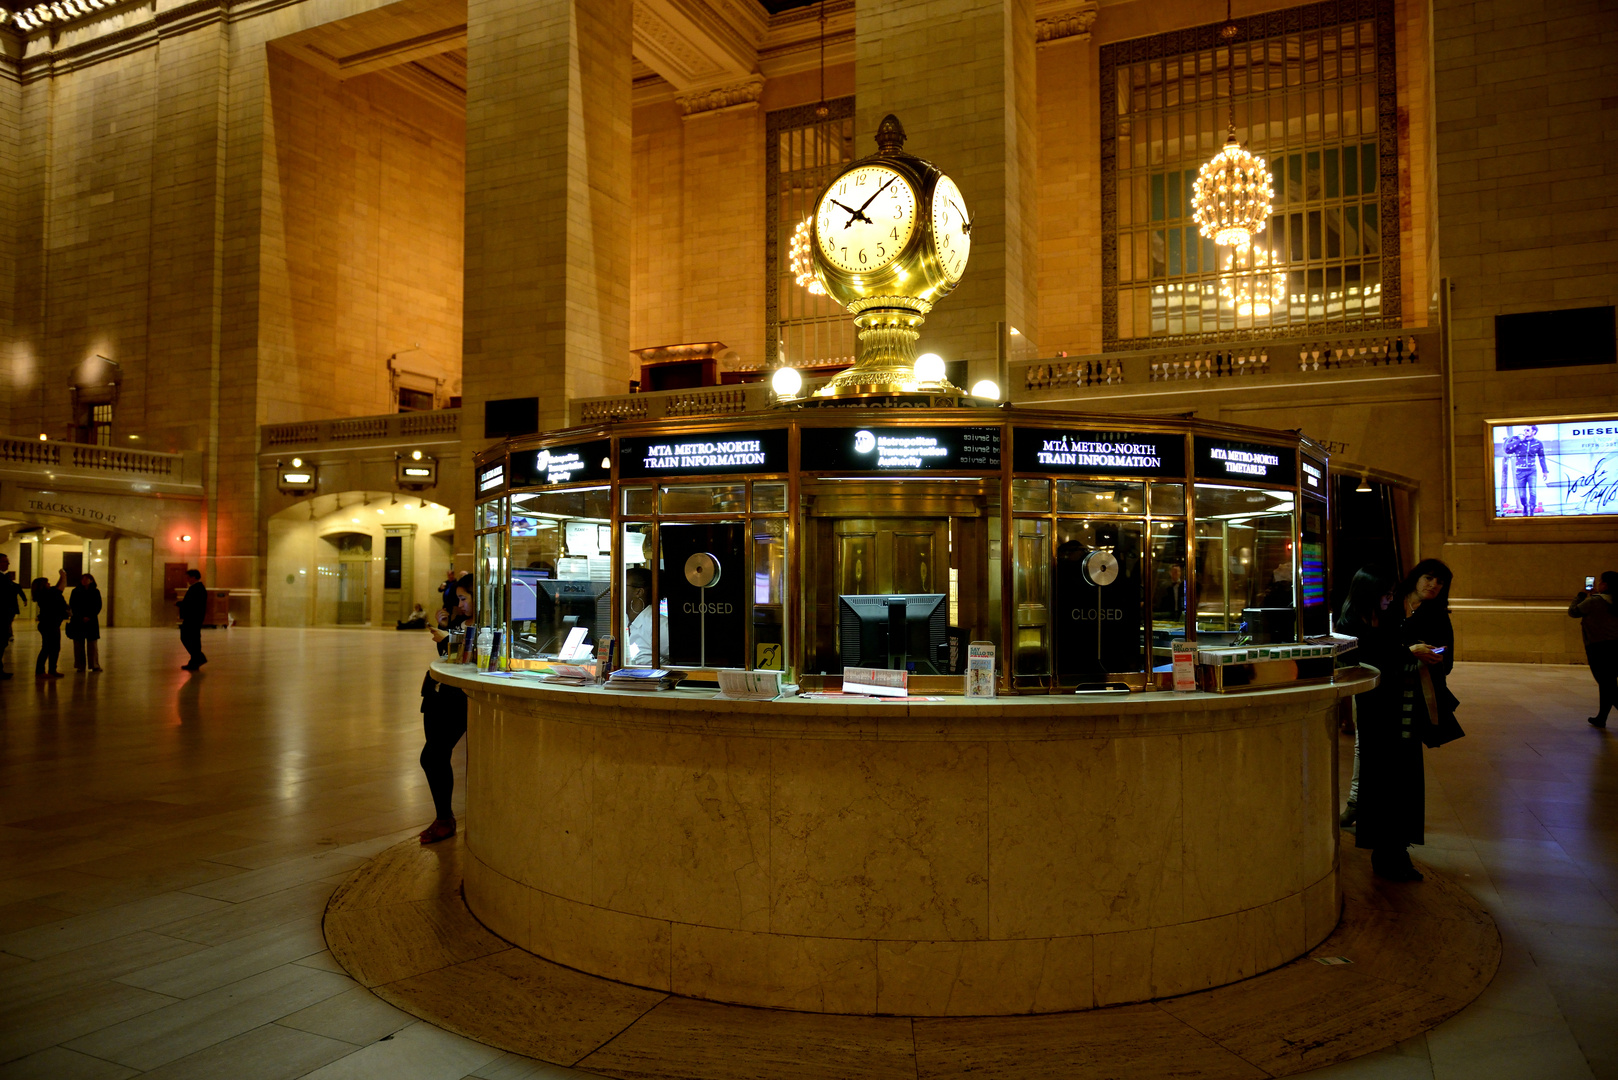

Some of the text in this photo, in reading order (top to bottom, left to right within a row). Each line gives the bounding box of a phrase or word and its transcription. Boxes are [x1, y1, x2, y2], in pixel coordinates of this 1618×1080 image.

[855, 173, 867, 187] 12
[839, 182, 847, 196] 11
[890, 185, 898, 199] 2
[893, 204, 903, 220] 3
[942, 211, 949, 227] 9
[823, 217, 830, 232] 9
[889, 225, 900, 241] 4
[828, 236, 836, 251] 8
[942, 233, 950, 249] 8
[841, 247, 847, 261] 7
[859, 248, 867, 264] 6
[876, 242, 885, 257] 5
[648, 444, 672, 456] MTA
[674, 440, 761, 456] METRO-NORTH
[1042, 440, 1156, 455] MTA METRO-NORTH
[643, 452, 766, 469] TRAIN INFORMATION
[1037, 452, 1161, 467] TRAIN INFORMATION
[1210, 448, 1279, 466] MTA METRO-NORTH
[1224, 461, 1267, 476] TIMETABLES
[28, 500, 74, 514] TRACKS
[75, 507, 86, 516] 31
[89, 509, 104, 520] TO
[683, 602, 733, 614] CLOSED
[1071, 608, 1123, 621] CLOSED
